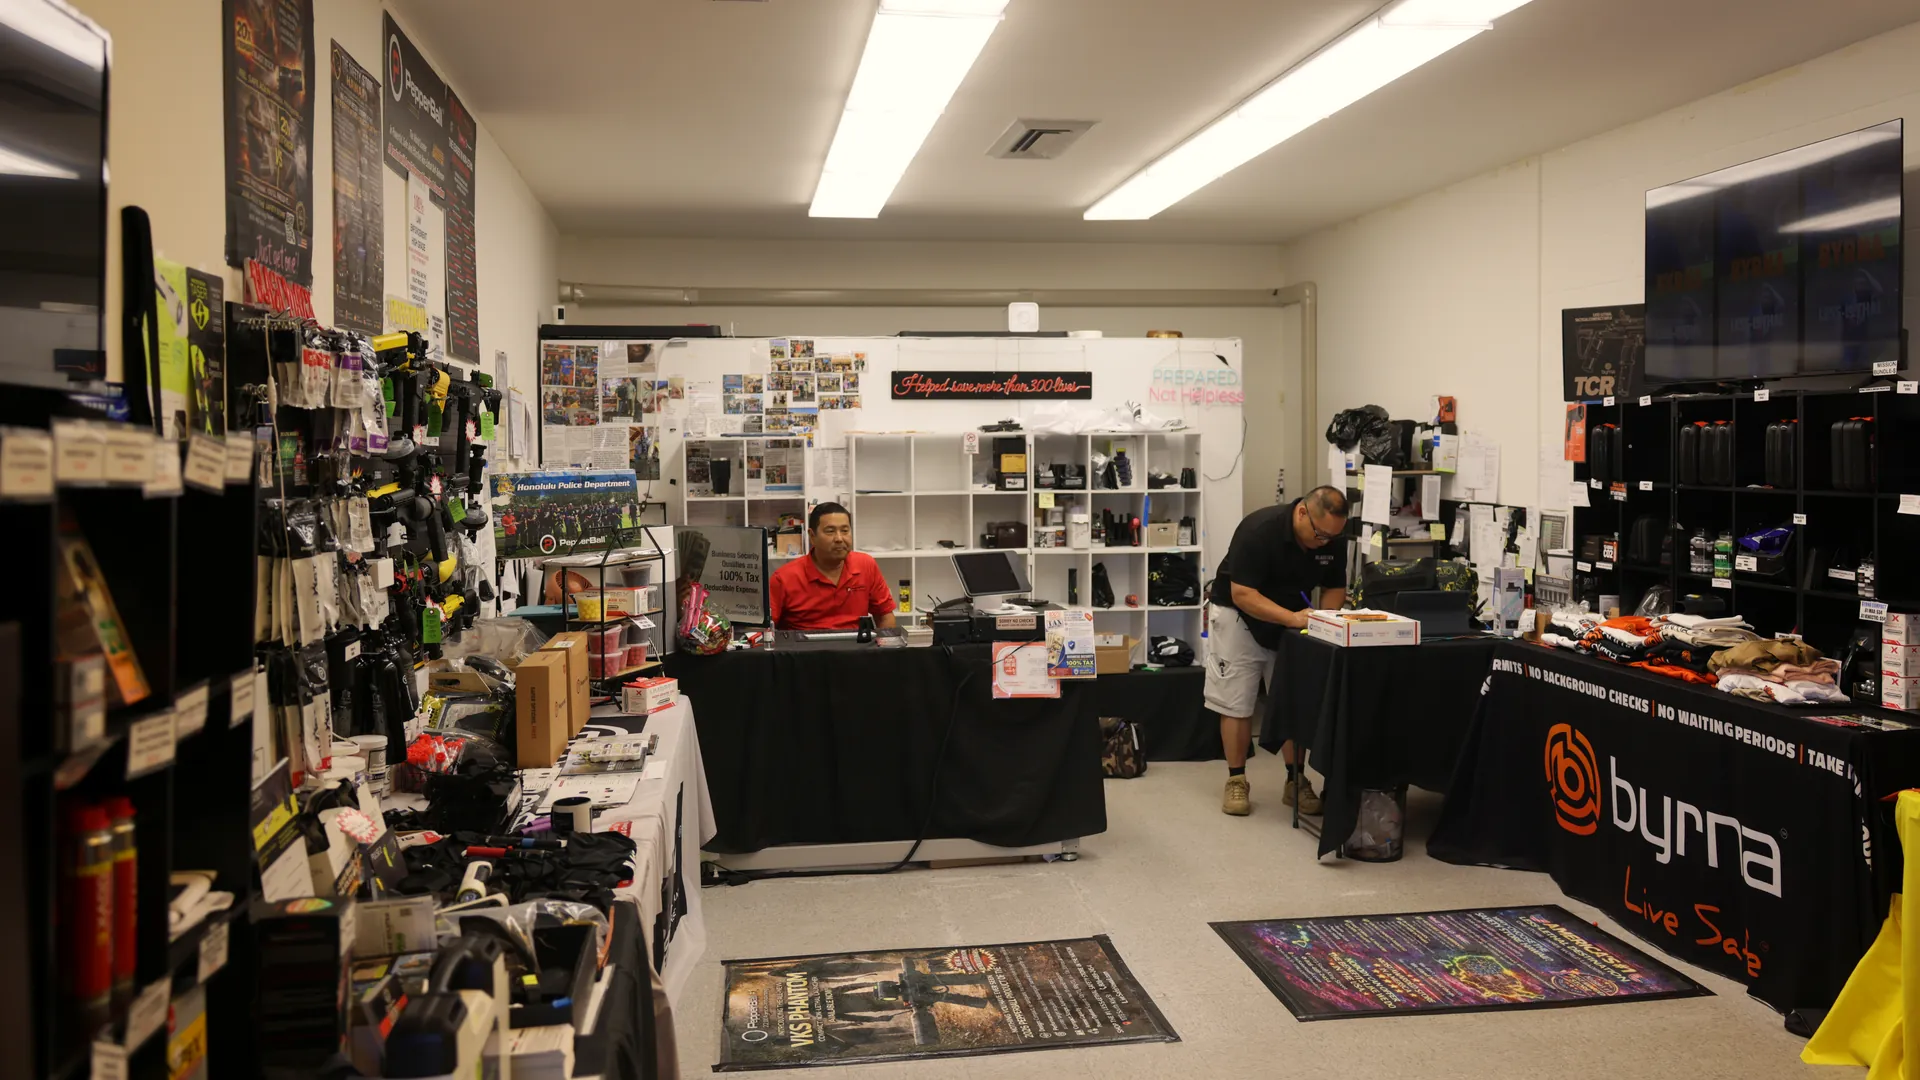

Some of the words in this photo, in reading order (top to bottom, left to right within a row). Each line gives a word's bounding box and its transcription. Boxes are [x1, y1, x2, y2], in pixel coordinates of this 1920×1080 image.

[405, 68, 443, 128] PepperBall
[894, 373, 950, 397] Helped
[950, 380, 974, 393] save
[975, 380, 1001, 393] more
[1003, 374, 1028, 395] than
[1027, 379, 1052, 393] 300
[1149, 387, 1176, 401] Not
[1181, 387, 1246, 405] Helpless
[1574, 376, 1615, 396] TCR
[517, 483, 556, 491] Honolulu
[584, 480, 630, 488] Department
[560, 536, 606, 548] PeperBall
[737, 552, 759, 560] Security
[720, 570, 743, 581] 100%
[746, 572, 760, 582] Tax
[1493, 658, 1522, 675] RMITS
[1528, 666, 1542, 680] NO
[1543, 670, 1606, 700] BACKGROUND
[1608, 690, 1649, 714] CHECKS
[1658, 704, 1675, 721] NO
[1678, 709, 1734, 738] WAITING
[1735, 726, 1796, 759] PERIODS
[1808, 748, 1845, 776] TAKE
[1610, 755, 1782, 898] byrna
[1624, 864, 1679, 936] Live
[1564, 945, 1633, 982] DESTINATION
[785, 971, 813, 1020] PHANTOM
[998, 979, 1015, 998] PRODUCT
[746, 994, 760, 1028] PepperBall
[825, 999, 837, 1022] AVAILABLE
[1006, 998, 1028, 1024] PEPPERBALL
[788, 1022, 815, 1047] VKS
